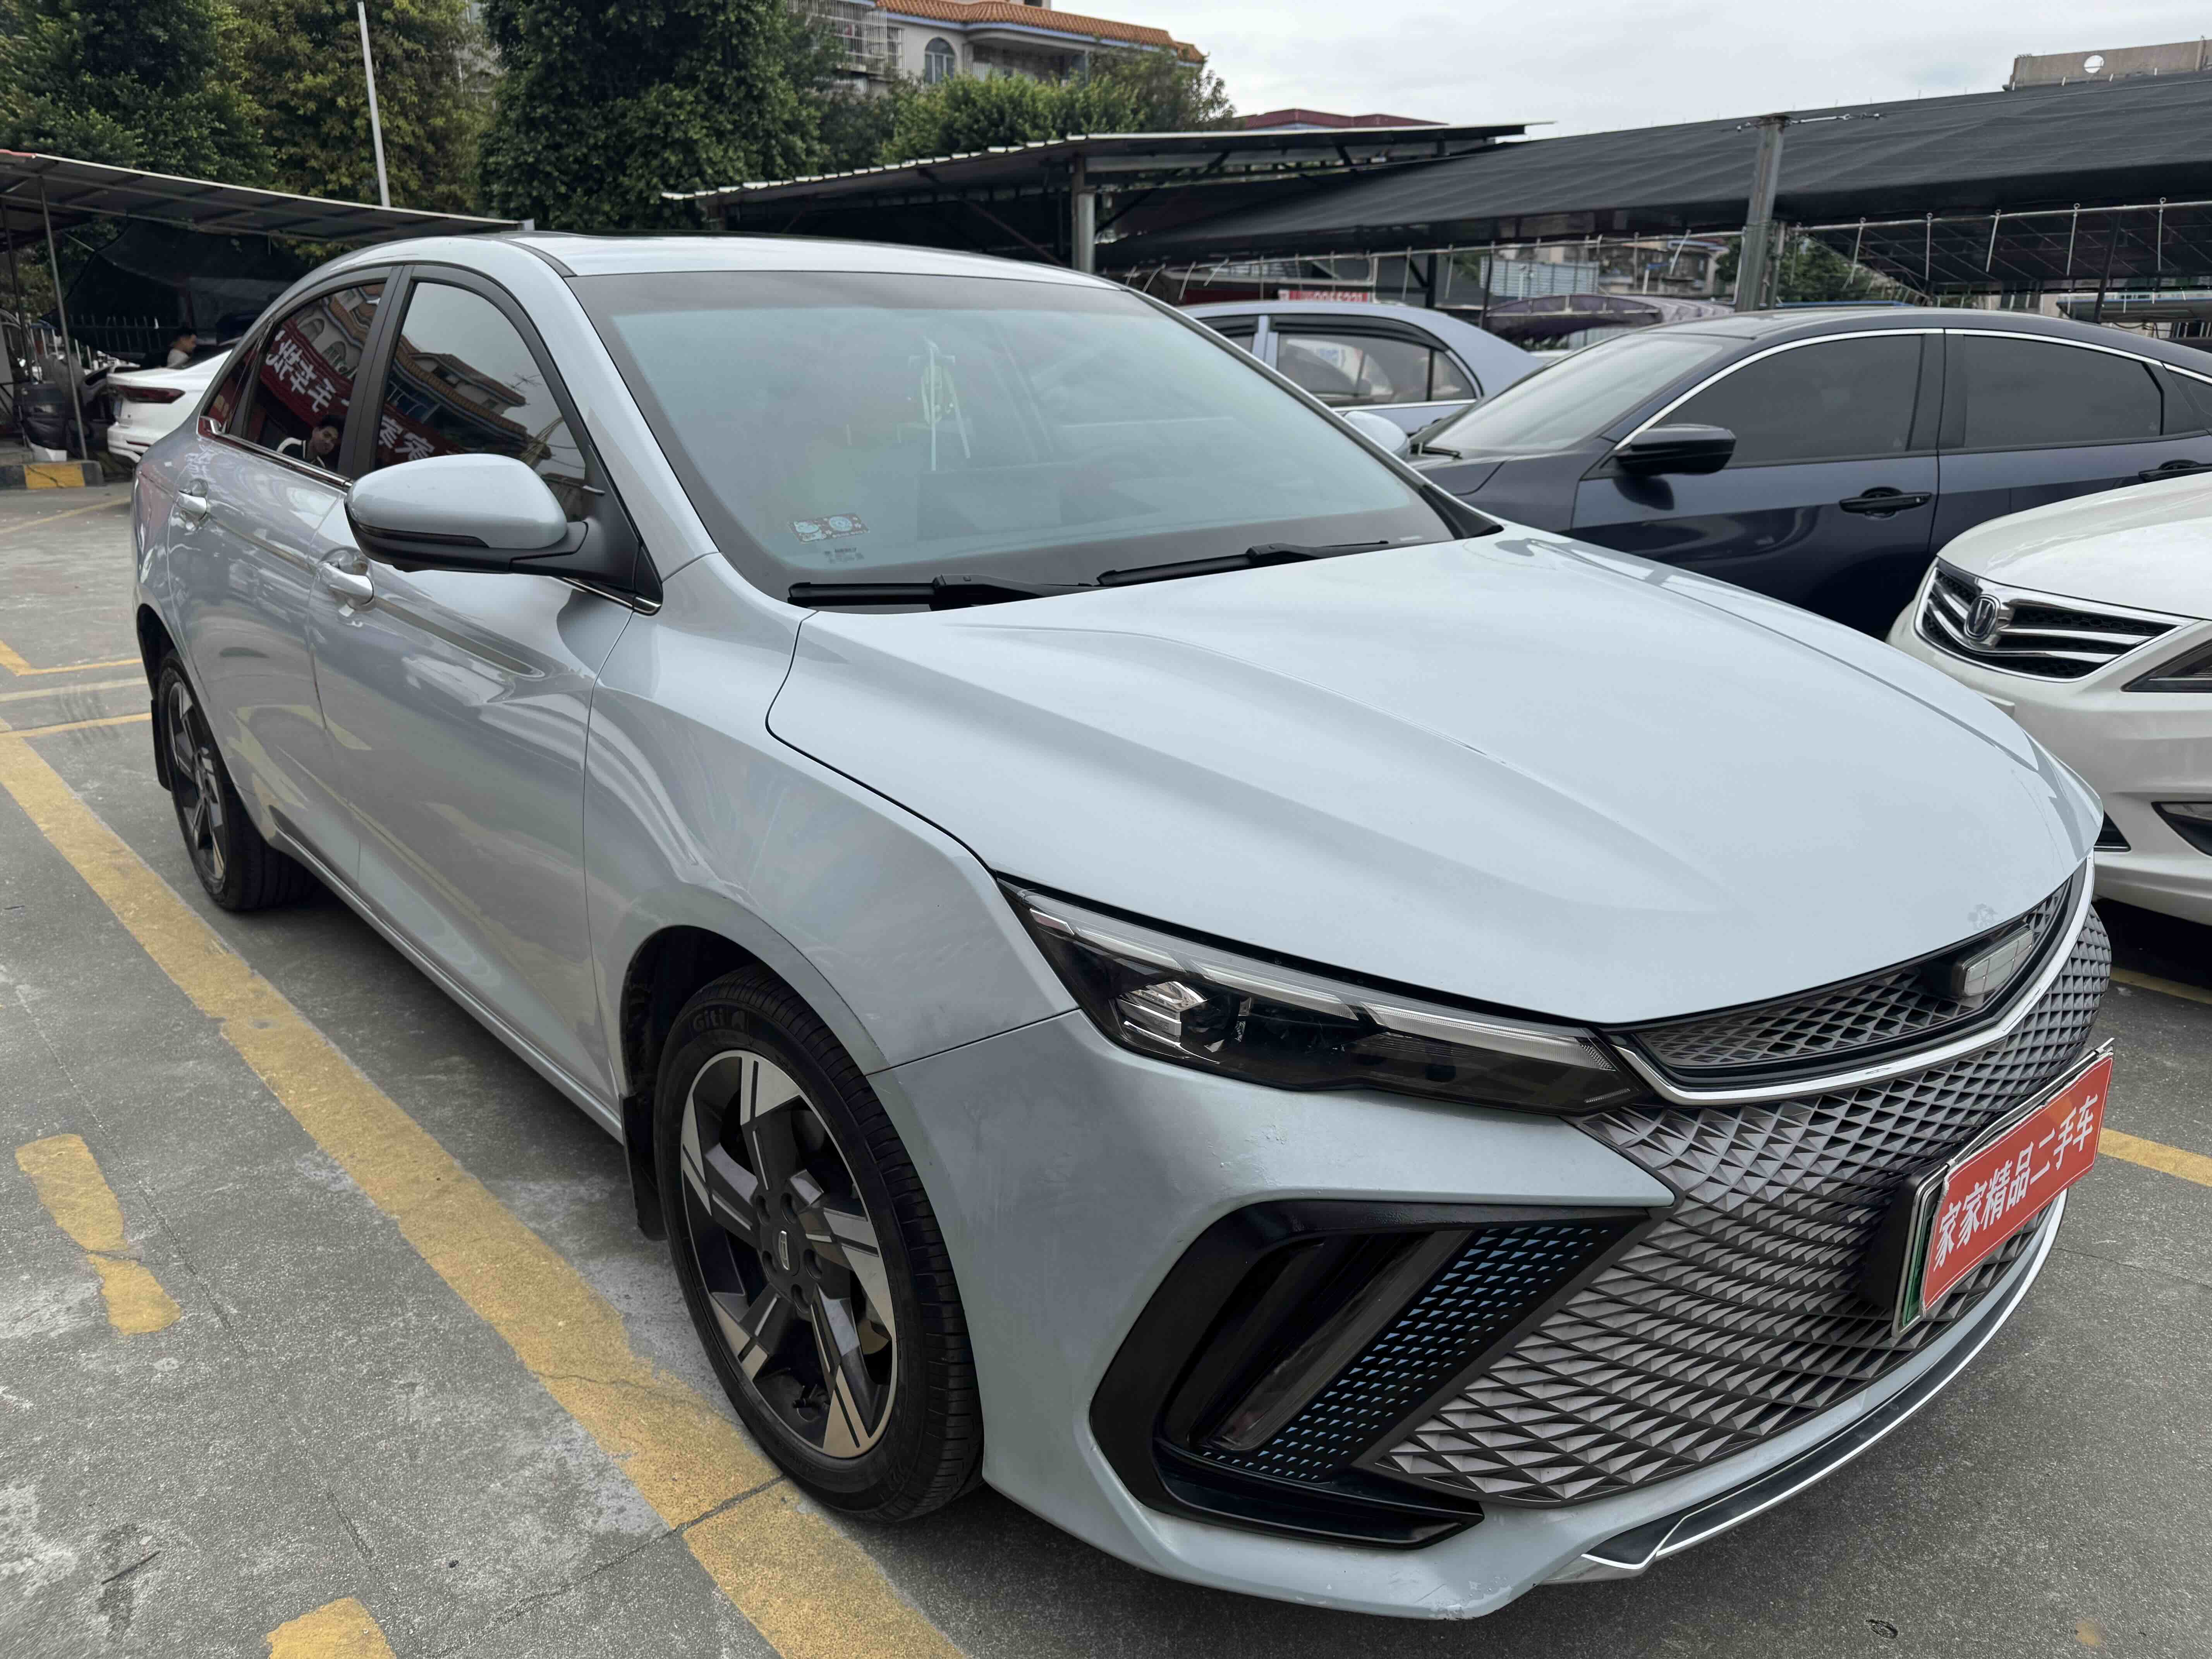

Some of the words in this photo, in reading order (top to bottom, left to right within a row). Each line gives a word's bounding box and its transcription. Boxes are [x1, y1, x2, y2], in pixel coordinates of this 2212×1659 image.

[1933, 1093, 2098, 1273] 家家精品二手车
